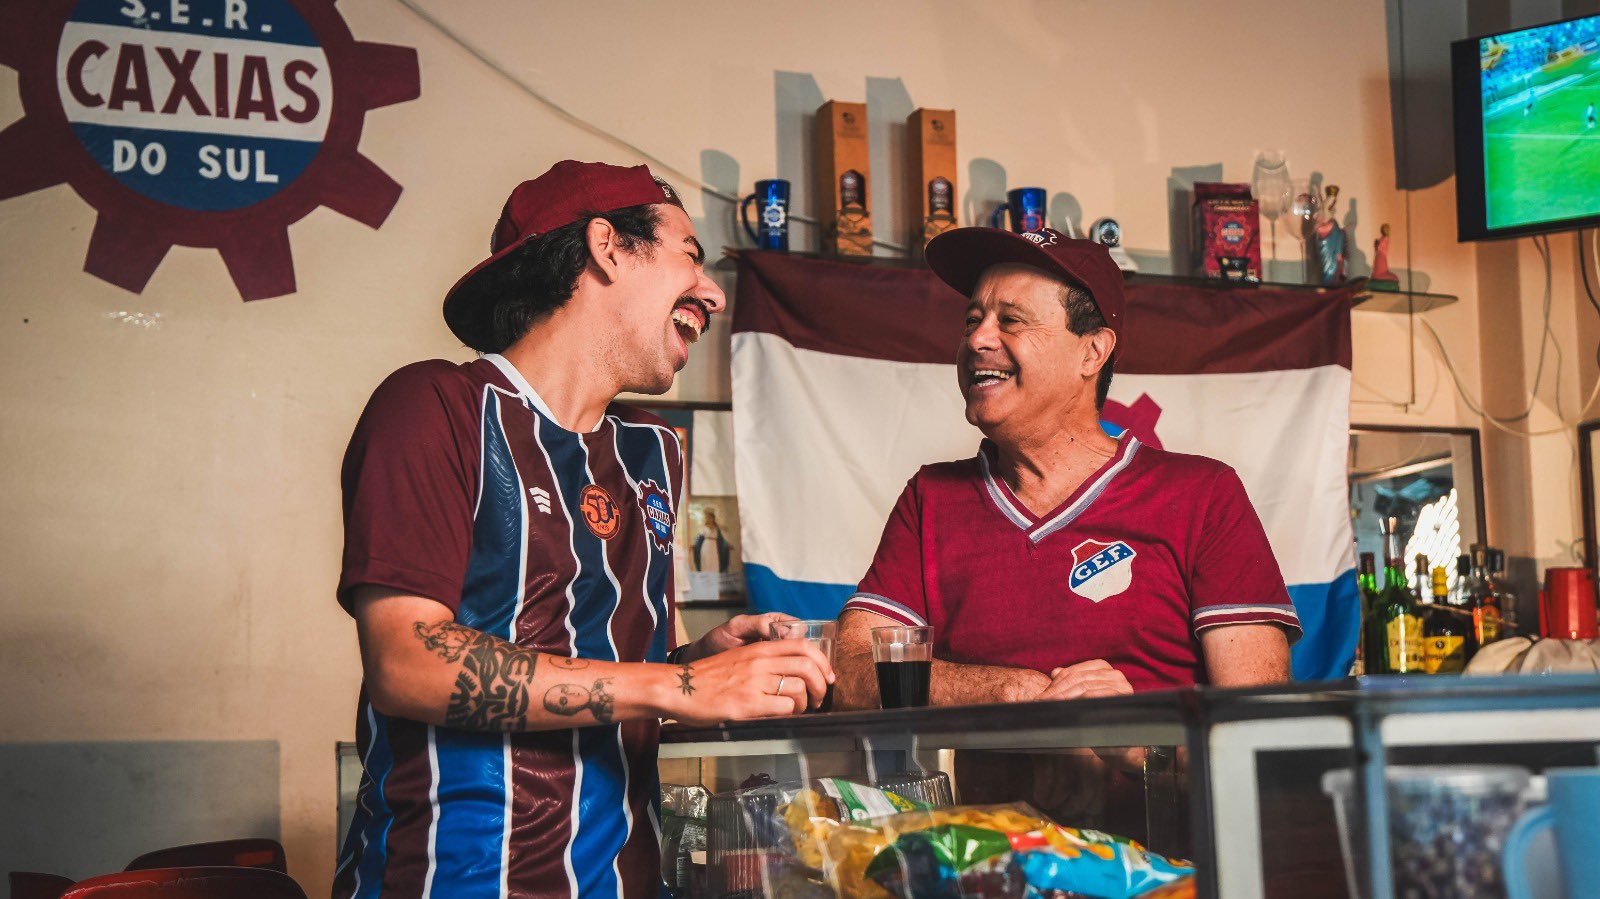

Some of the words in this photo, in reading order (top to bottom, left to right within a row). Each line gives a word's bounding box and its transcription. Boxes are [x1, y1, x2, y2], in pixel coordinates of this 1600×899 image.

[120, 0, 272, 32] S.E.R.
[66, 39, 321, 124] CAXIAS
[113, 139, 167, 176] DO
[198, 145, 279, 183] SUL
